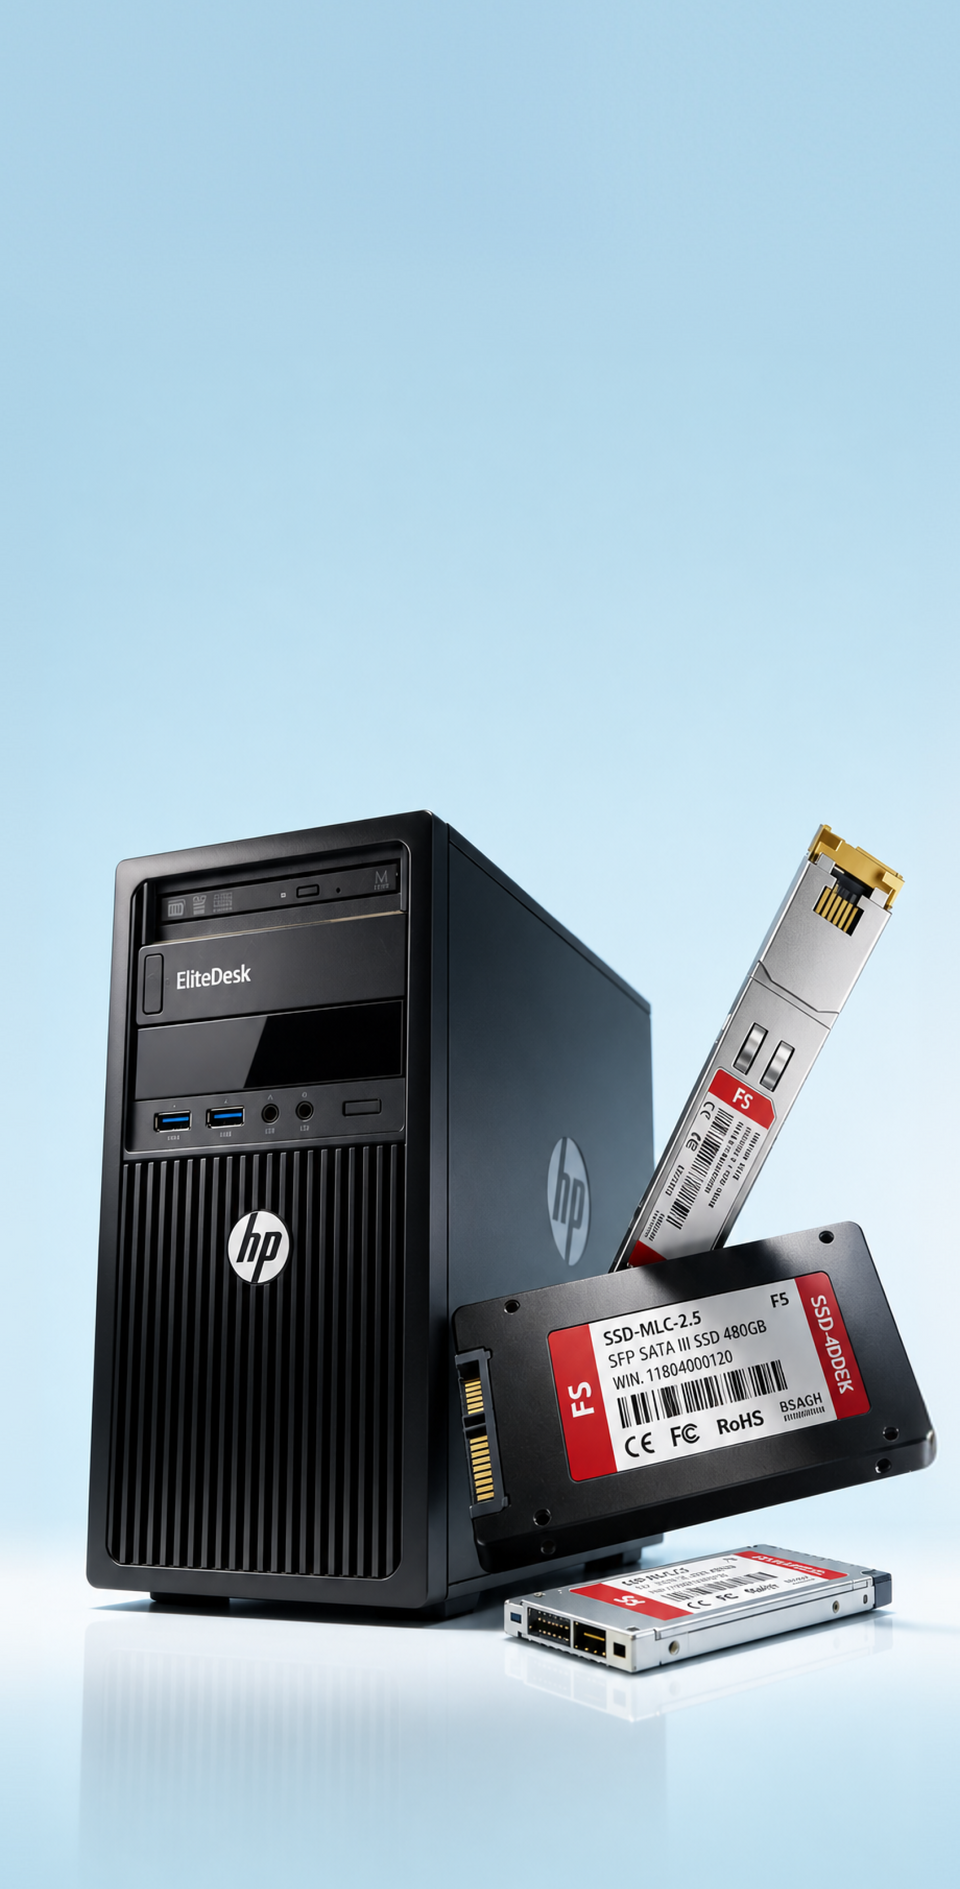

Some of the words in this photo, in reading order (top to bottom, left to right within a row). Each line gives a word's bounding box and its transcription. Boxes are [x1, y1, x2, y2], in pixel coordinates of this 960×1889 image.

[176, 963, 252, 990] EliteDesk
[732, 1087, 754, 1110] FS
[551, 1136, 587, 1265] hp
[235, 1211, 283, 1283] hp
[603, 1310, 702, 1346] SSD-MLC-2.5
[608, 1347, 636, 1369] SFP
[639, 1340, 676, 1363] SATA
[678, 1336, 691, 1352] III
[694, 1329, 721, 1349] SSD
[723, 1319, 767, 1341] 480GB
[613, 1371, 644, 1390] WIN.
[646, 1349, 733, 1384] 11804000120
[567, 1381, 595, 1418] FS
[779, 1392, 823, 1414] BSAGH
[624, 1432, 655, 1458] CE
[716, 1409, 765, 1435] RoHS
